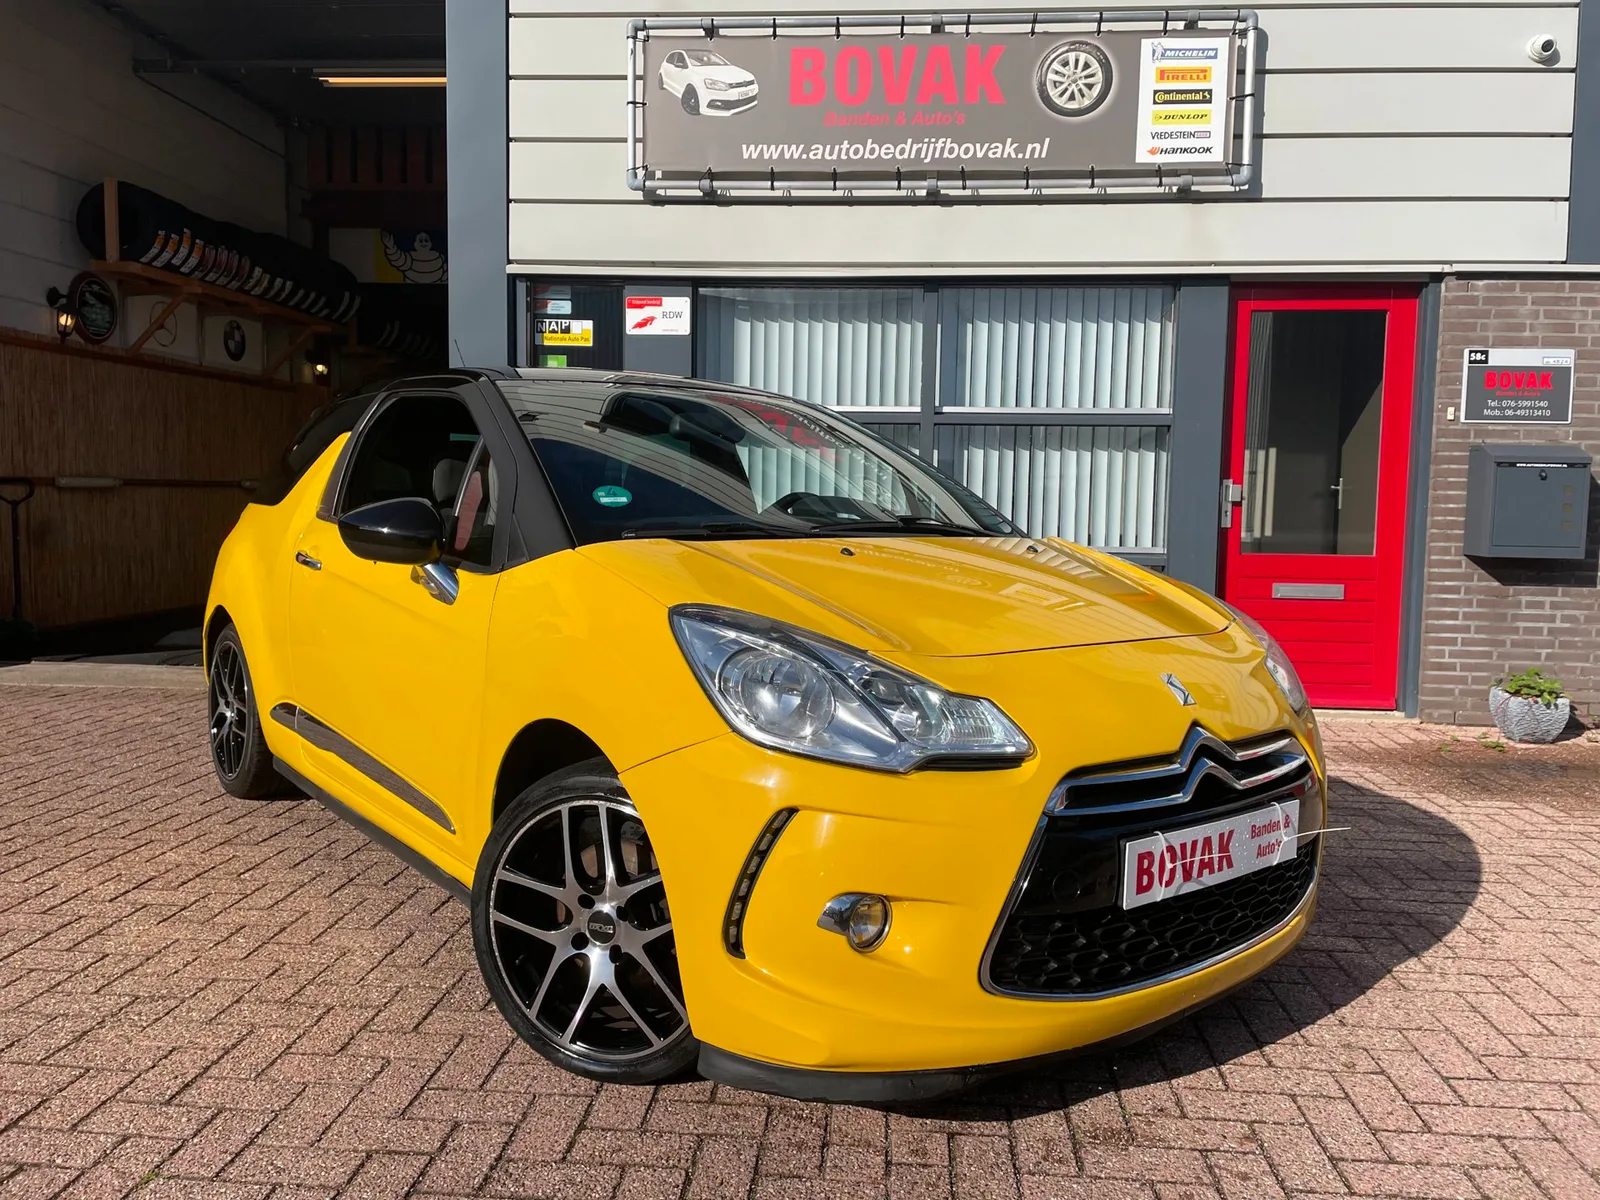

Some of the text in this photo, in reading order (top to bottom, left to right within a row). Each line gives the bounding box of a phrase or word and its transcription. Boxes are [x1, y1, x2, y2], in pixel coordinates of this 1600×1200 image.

[1164, 49, 1216, 57] MICHELIN
[788, 44, 1007, 107] BOVAK
[1159, 69, 1208, 81] PIRELLI
[1155, 91, 1203, 103] Continental
[823, 109, 966, 127] Banden & Auto's
[1163, 113, 1208, 121] DUNLOP
[1150, 131, 1196, 140] VREDESTEIN
[741, 137, 1051, 163] www.autobedrijfbovak.nl
[661, 311, 683, 319] RDW
[1469, 352, 1486, 361] 58c
[1484, 371, 1554, 390] BOVAK
[1502, 400, 1548, 408] 076-5991540
[1250, 814, 1291, 840] Banden &
[1136, 828, 1235, 896] BOVAK
